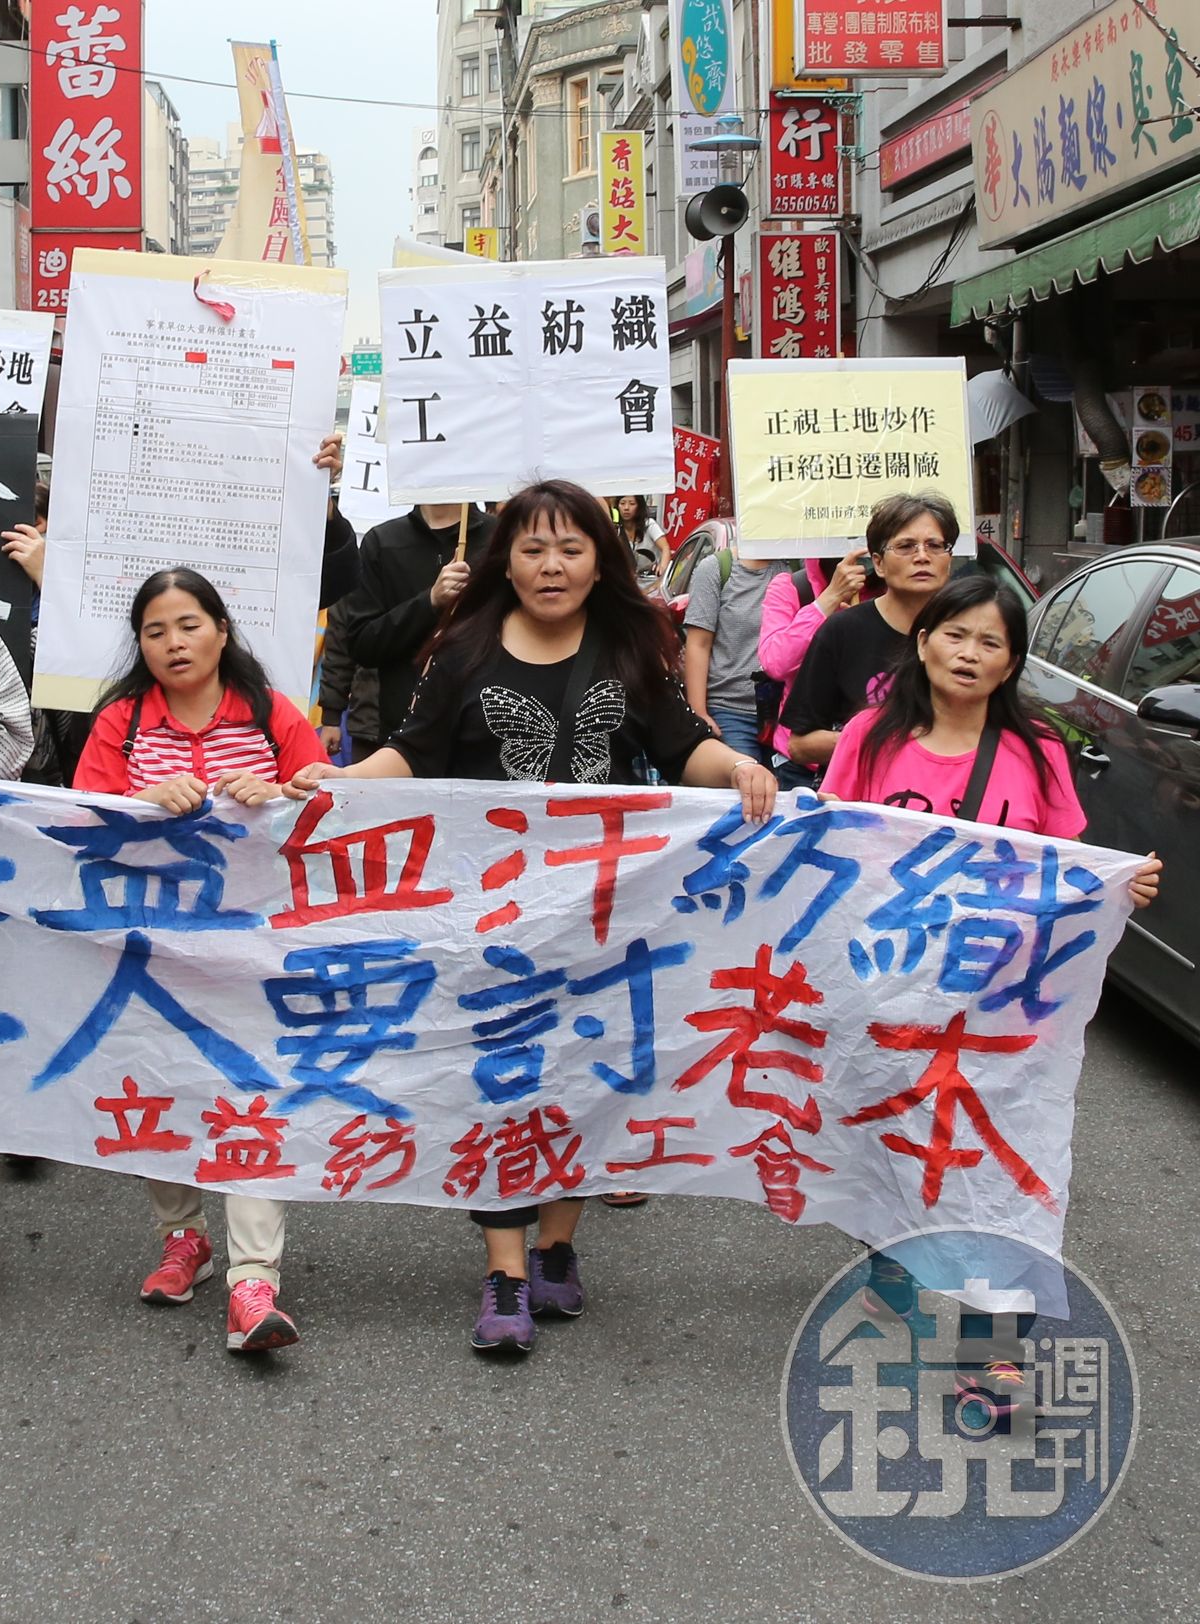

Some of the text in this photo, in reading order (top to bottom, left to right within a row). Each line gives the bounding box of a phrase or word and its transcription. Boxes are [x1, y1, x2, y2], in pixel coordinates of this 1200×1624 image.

[808, 40, 939, 64] 批發零售
[42, 5, 132, 209] 蕾絲
[609, 138, 640, 254] 香菇大
[398, 295, 658, 361] 立益紡織
[764, 406, 936, 436] 正視土地炒作
[768, 452, 939, 482] 拒絕迫遷關廠
[94, 1075, 836, 1224] 立益紡織工會
